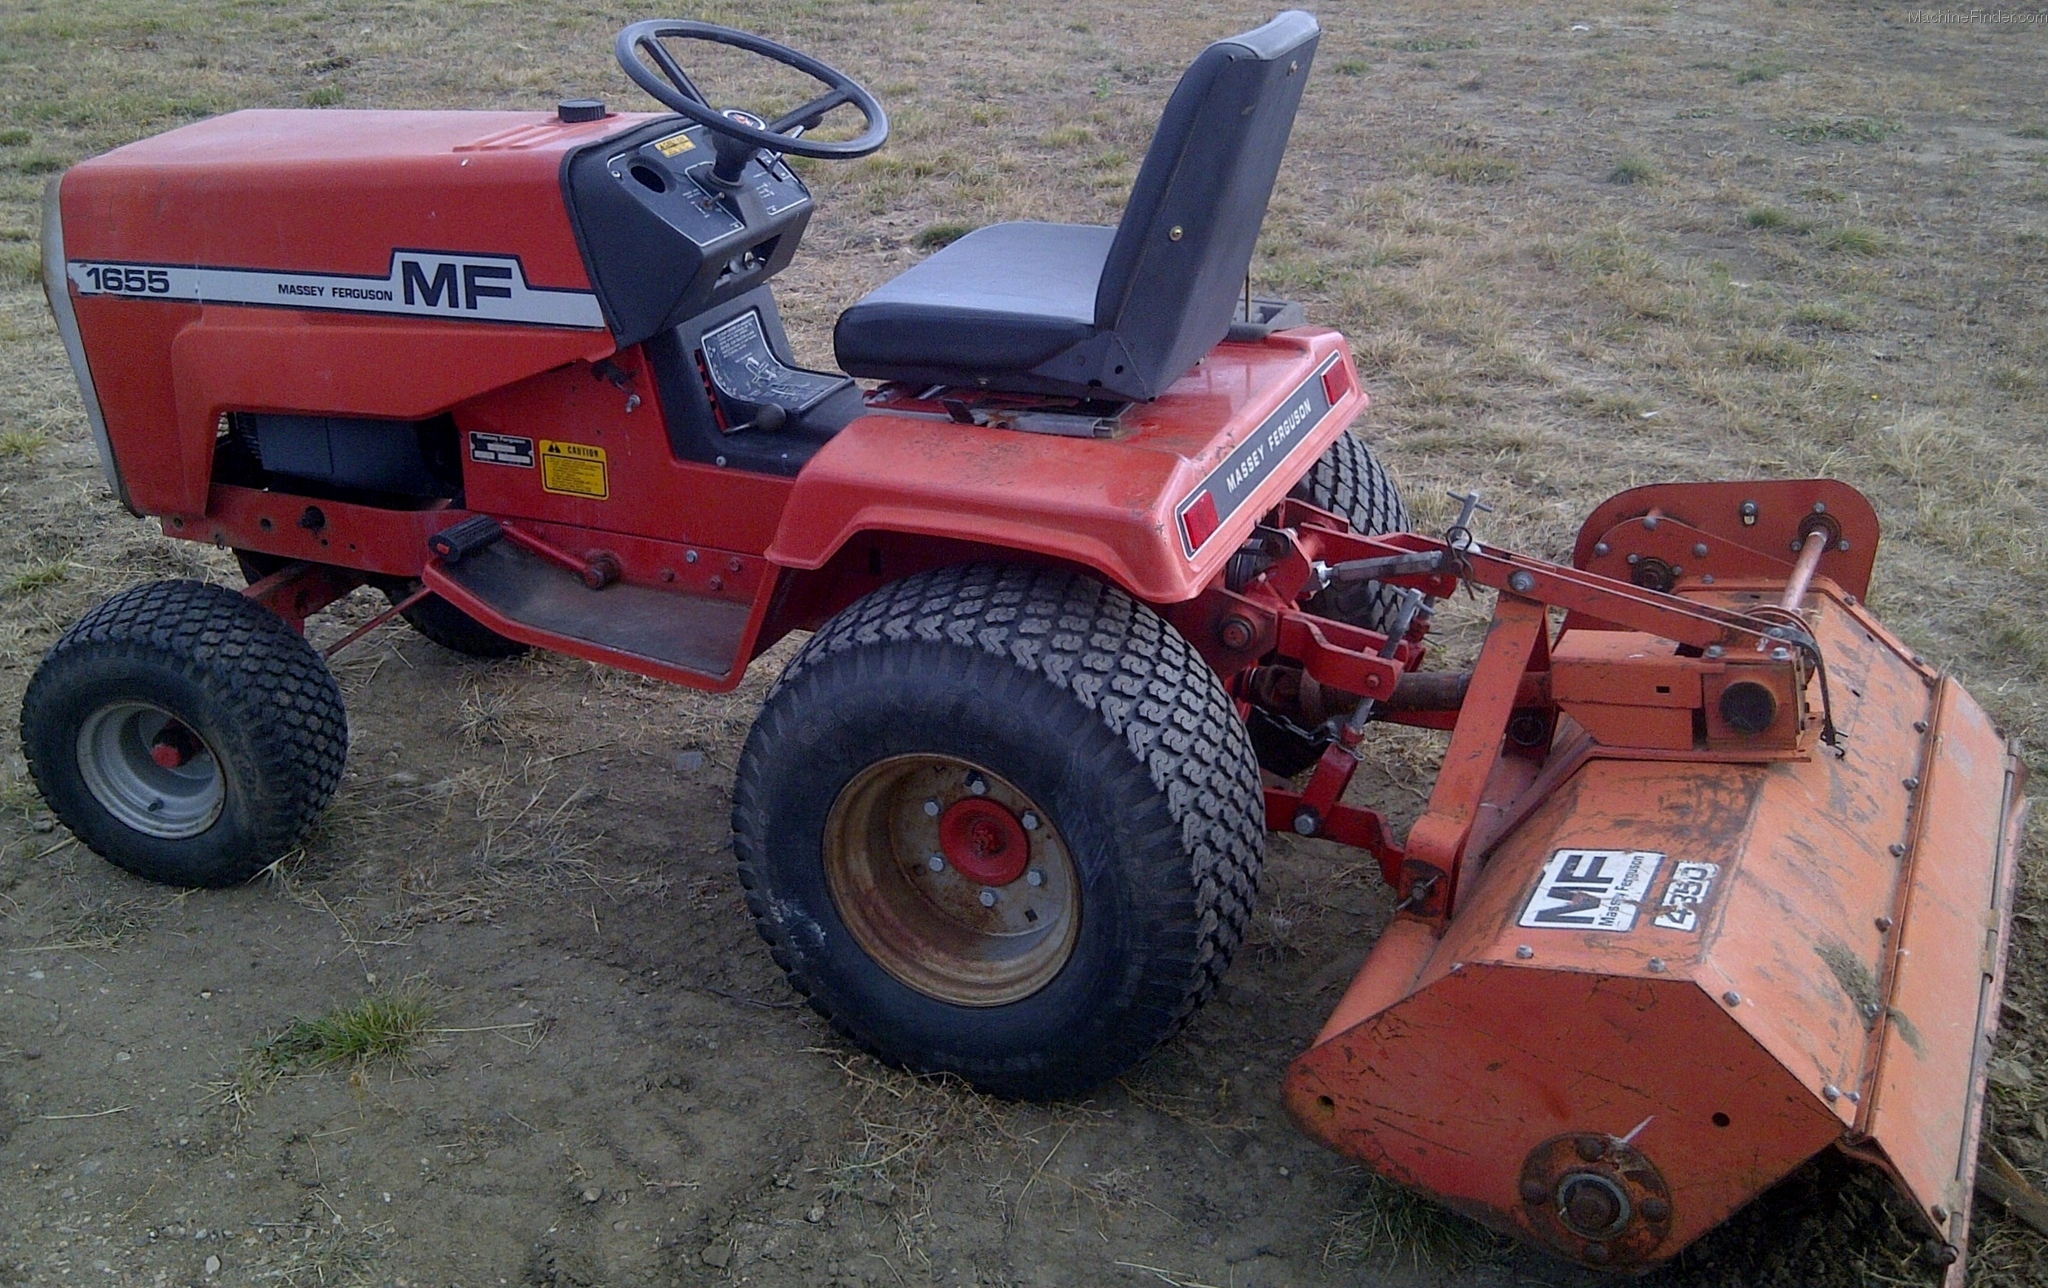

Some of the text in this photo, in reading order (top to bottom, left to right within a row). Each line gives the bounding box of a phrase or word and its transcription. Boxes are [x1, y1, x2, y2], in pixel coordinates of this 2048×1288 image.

[85, 267, 170, 293] 1655
[277, 283, 393, 301] MASSEY FERGUSON
[401, 260, 513, 310] MF
[567, 445, 599, 458] CAUTION
[1226, 398, 1312, 493] MASSEY FERGUSON
[1534, 854, 1614, 924] MF
[1598, 855, 1645, 927] Massy Ferguson
